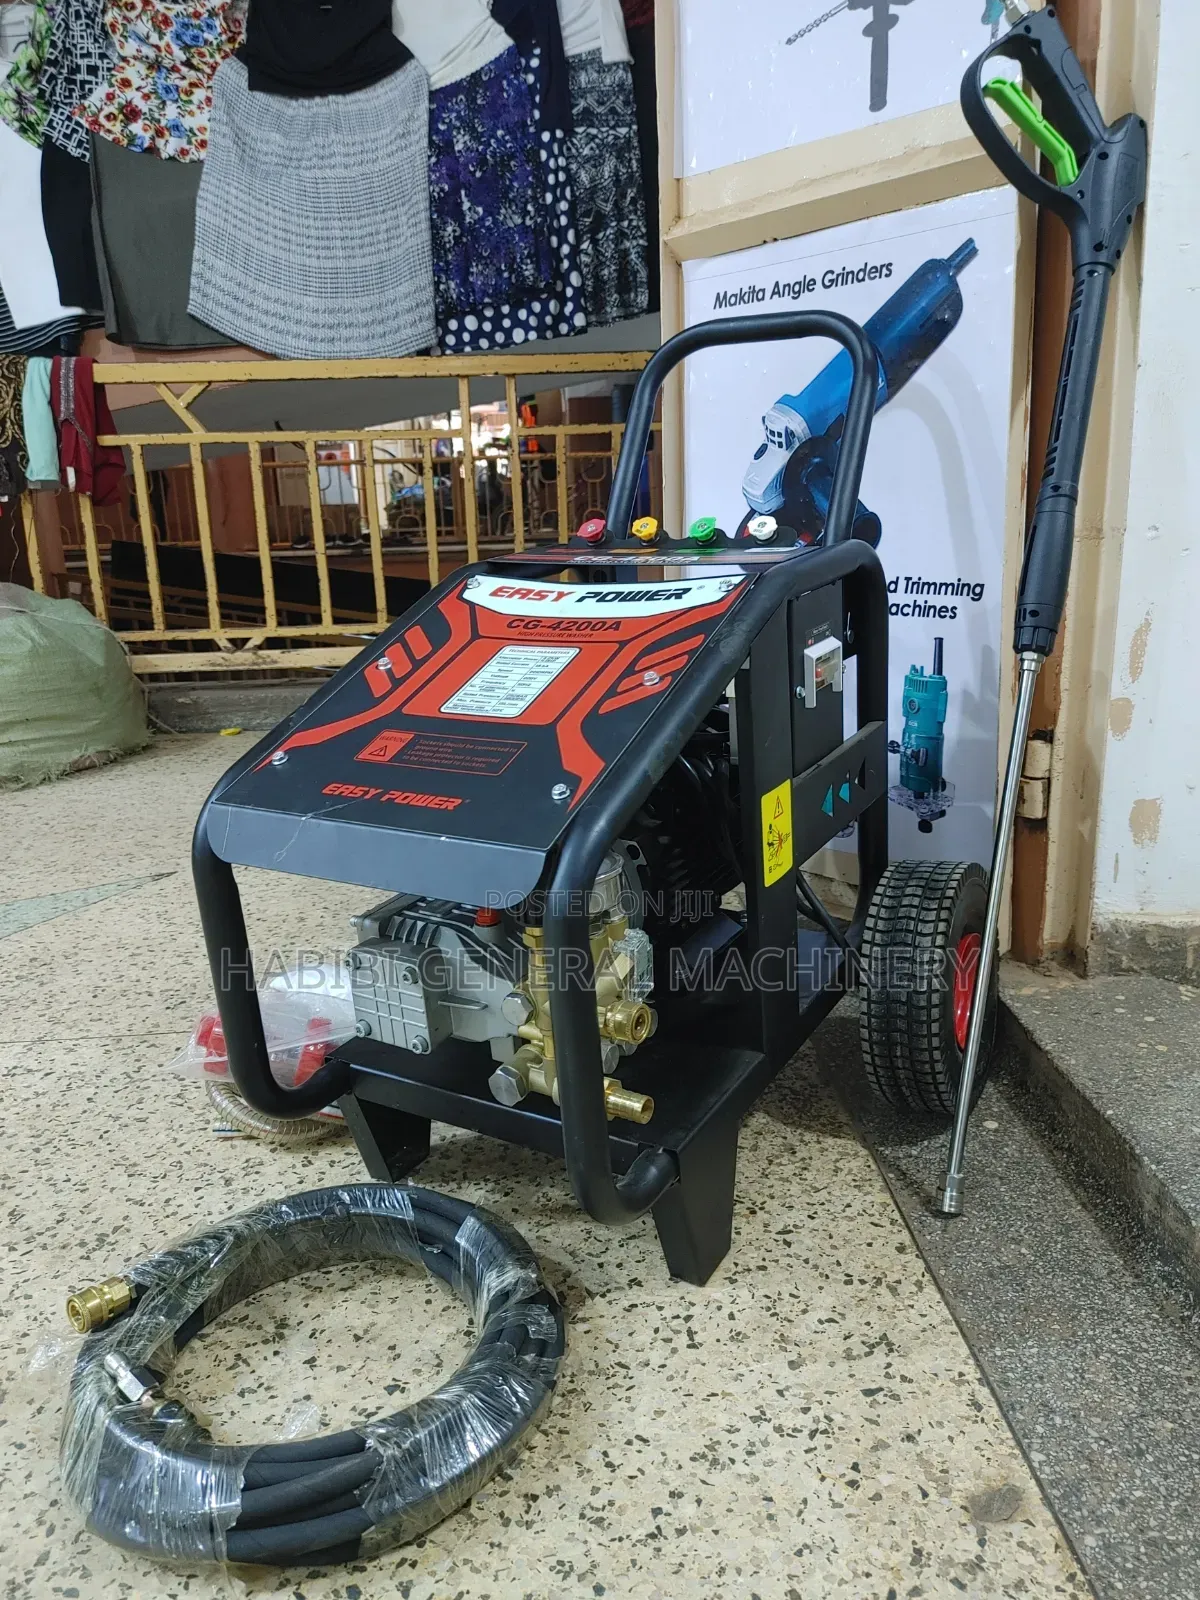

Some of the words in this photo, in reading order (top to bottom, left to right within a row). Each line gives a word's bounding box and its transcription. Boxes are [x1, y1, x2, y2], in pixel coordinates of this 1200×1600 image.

[713, 285, 766, 310] Makita
[770, 275, 817, 301] Angle
[821, 262, 893, 290] Grinders
[488, 585, 576, 602] EASY
[575, 587, 692, 603] POWER
[904, 576, 985, 602] Trimming
[888, 599, 958, 620] achines
[506, 618, 622, 632] CG-4200A
[379, 736, 408, 744] WARNING
[470, 756, 501, 764] required
[321, 783, 384, 800] EASY
[380, 790, 464, 811] POWER
